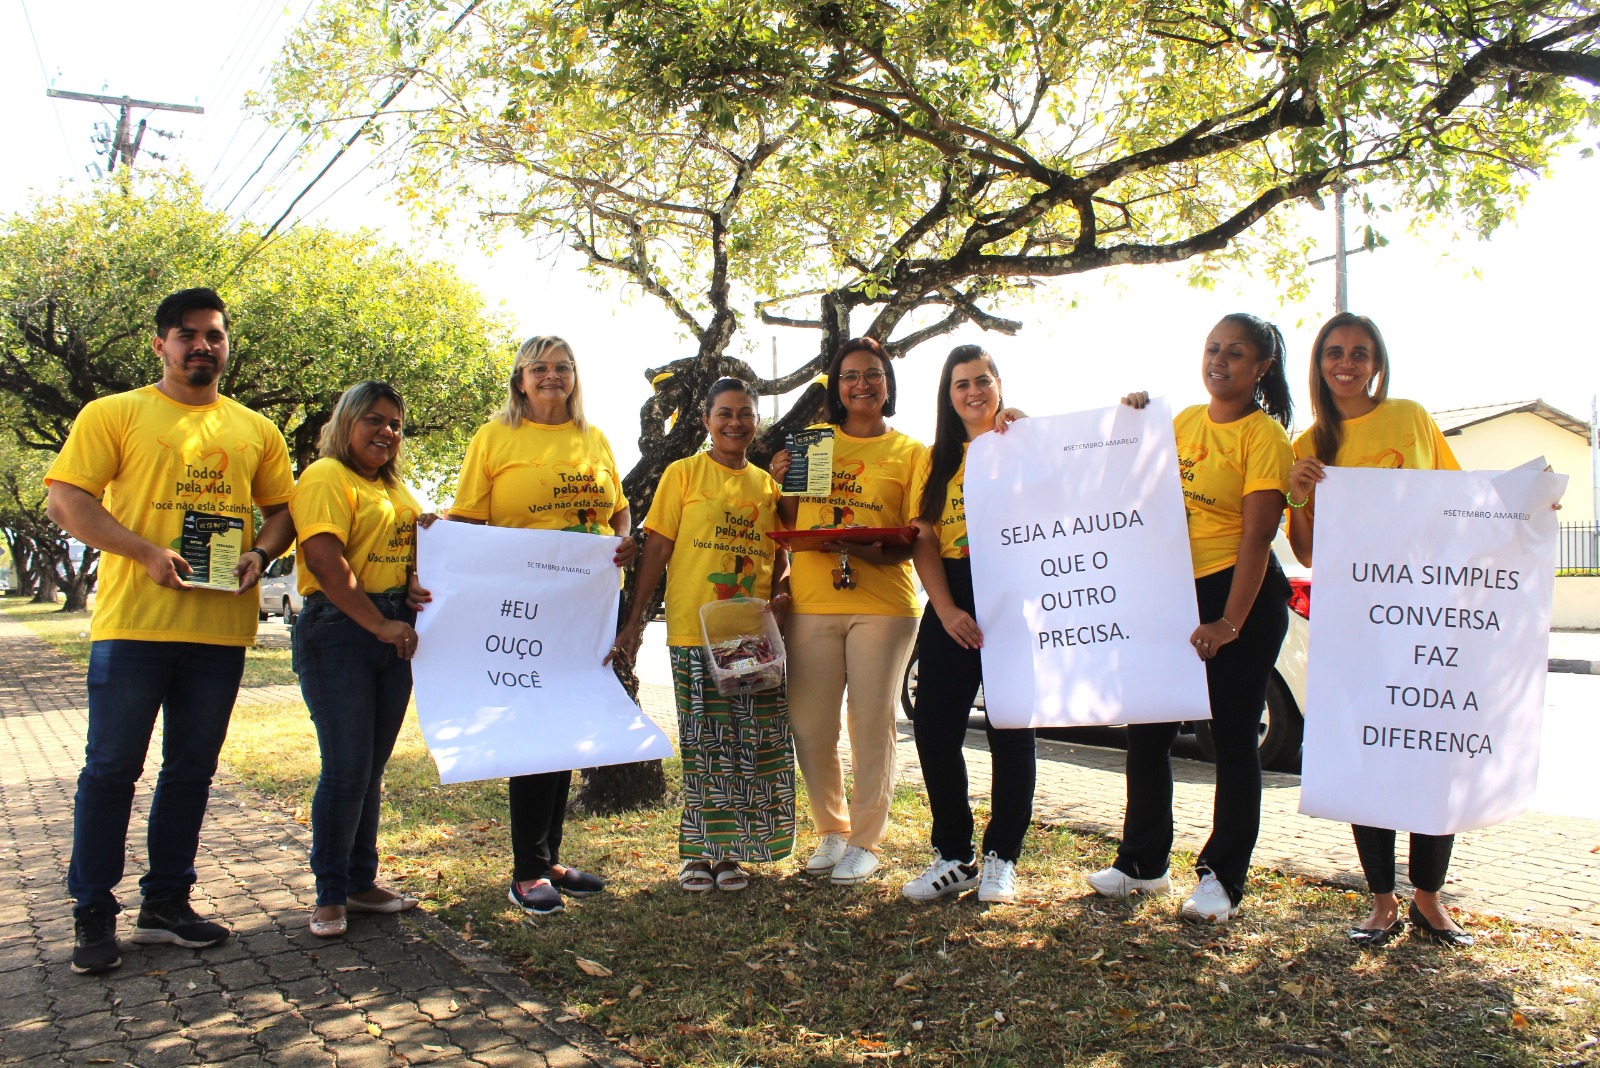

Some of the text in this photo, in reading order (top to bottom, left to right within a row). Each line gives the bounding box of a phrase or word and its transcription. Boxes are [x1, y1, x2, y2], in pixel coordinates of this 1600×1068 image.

[1063, 437, 1139, 452] #SETEMBRO AMARELO
[186, 464, 224, 480] Todos
[558, 472, 595, 482] Todos
[832, 470, 857, 480] odos
[176, 480, 232, 495] pela vida
[553, 483, 605, 498] pela vida
[838, 482, 863, 494] vida
[176, 501, 194, 511] não
[197, 501, 216, 511] está
[528, 502, 553, 513] Você
[554, 501, 572, 510] não
[573, 499, 591, 508] está
[848, 498, 884, 512] Sozinho!
[724, 511, 755, 528] Todos
[941, 515, 955, 526] ocê
[1443, 509, 1531, 521] #SETEMBRO AMARELO
[715, 525, 761, 541] pela vida
[1000, 509, 1144, 546] SEJA A AJUDA
[693, 539, 712, 549] Você
[714, 542, 730, 551] não
[731, 545, 747, 554] está
[527, 561, 560, 572] SETEMBRO
[1040, 551, 1109, 578] QUE O
[1352, 562, 1520, 591] UMA SIMPLES
[1040, 585, 1117, 612] OUTRO
[500, 599, 539, 620] #EU
[1369, 604, 1501, 632] CONVERSA
[1038, 622, 1130, 650] PRECISA.
[485, 634, 543, 660] OUÇO
[1413, 644, 1459, 668] FAZ
[487, 670, 543, 689] VOCÊ
[1385, 685, 1479, 711] TODA A
[1362, 725, 1493, 759] DIFERENÇA
